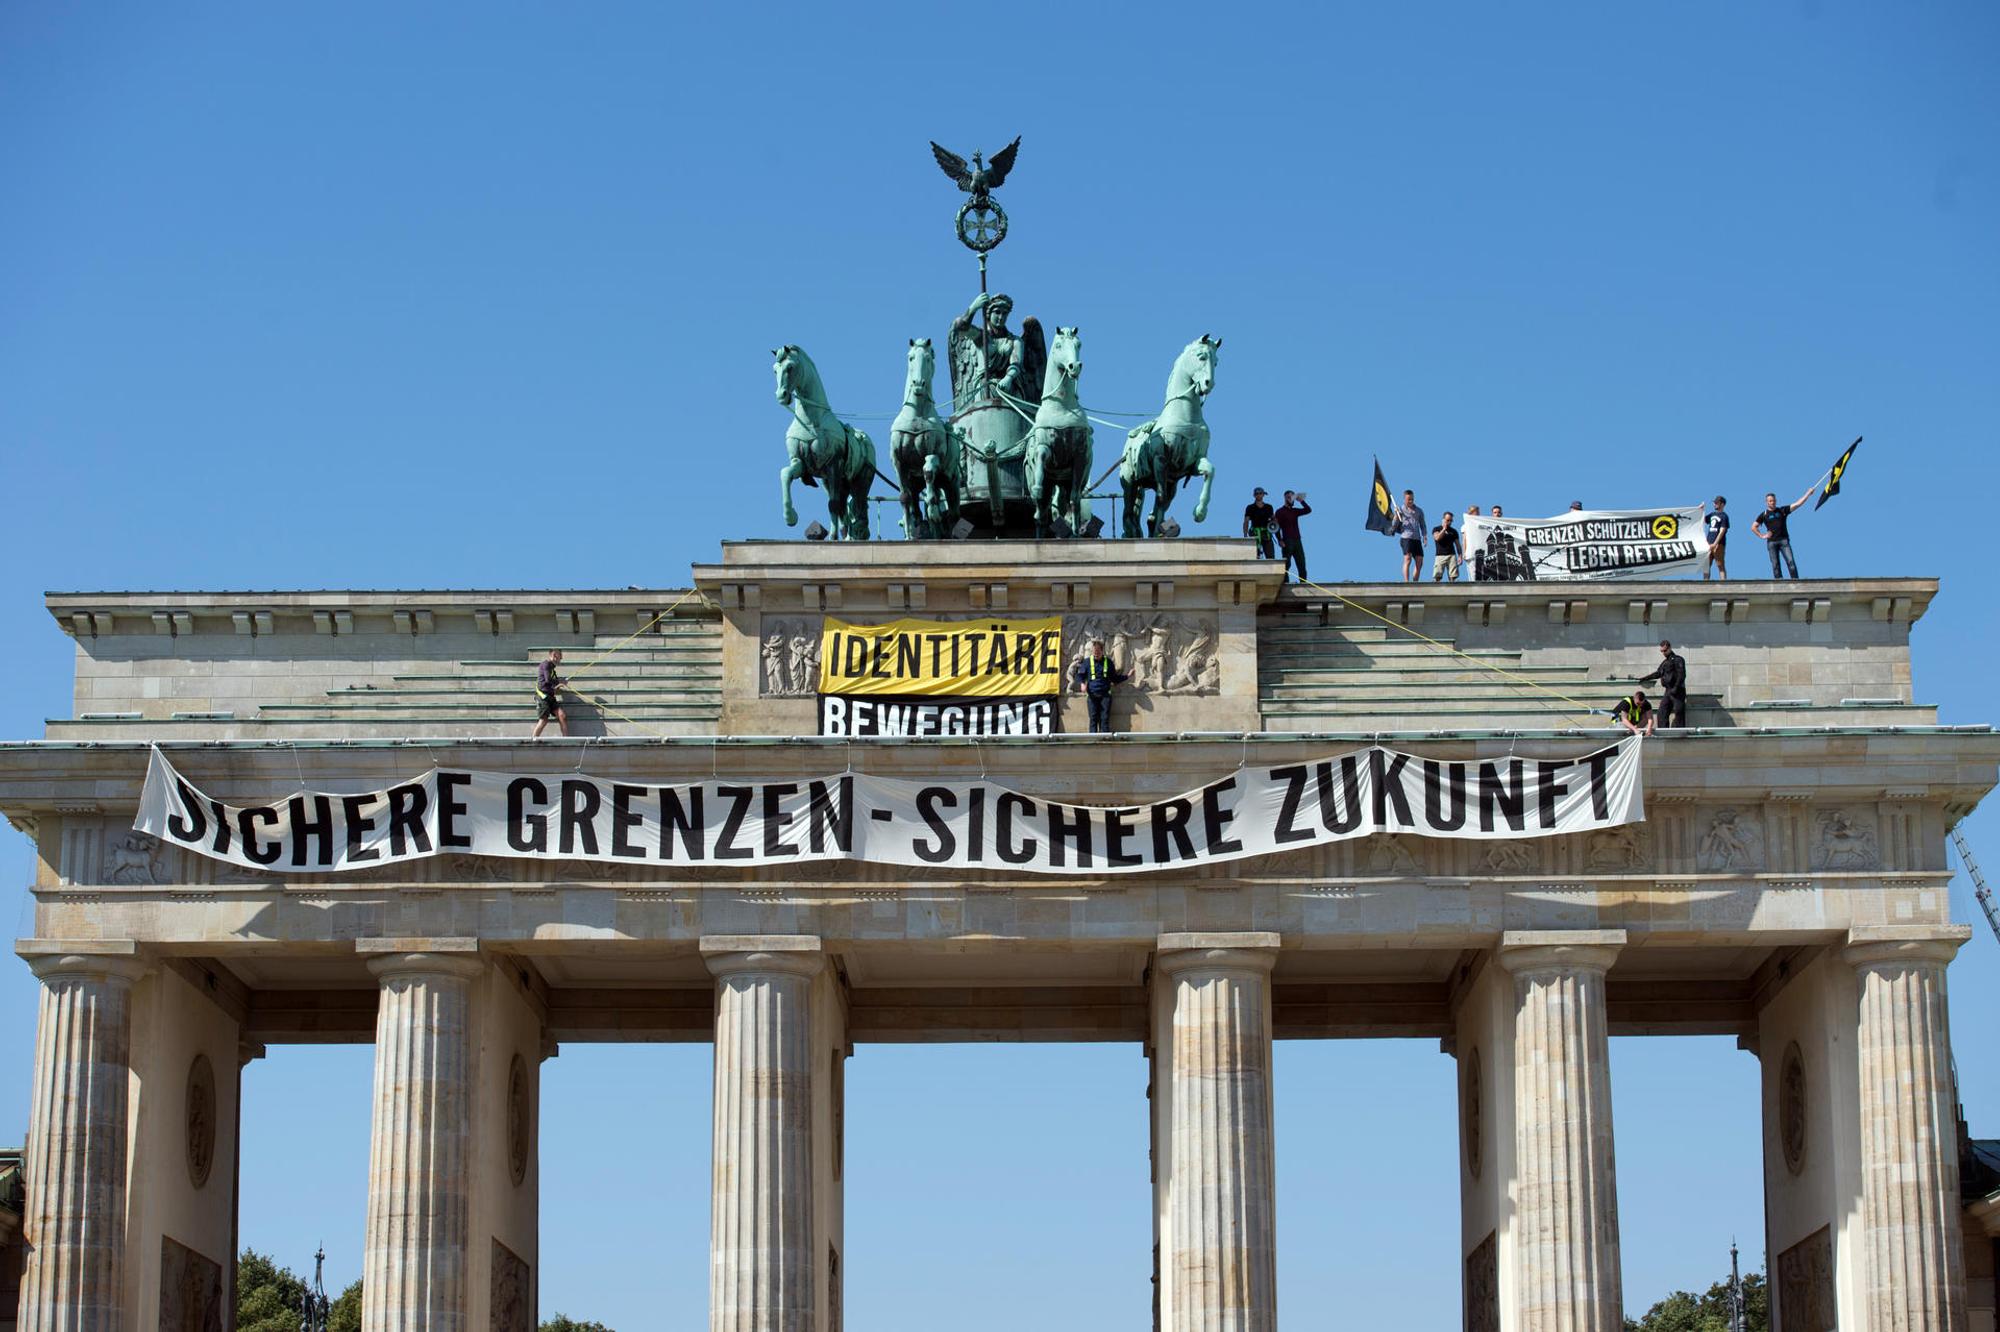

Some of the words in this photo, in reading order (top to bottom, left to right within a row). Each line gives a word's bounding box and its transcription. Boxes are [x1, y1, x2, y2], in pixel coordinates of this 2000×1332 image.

[1528, 524, 1584, 545] GRENZEN
[1587, 518, 1651, 541] SCHÜTZEN!
[1569, 546, 1619, 571] LEBEN
[1625, 542, 1693, 565] RETTEN!
[830, 624, 1060, 679] IDENTITÄRE
[823, 696, 1051, 737] BEWEGUNG
[168, 772, 472, 865] SICHERE
[507, 776, 854, 861] GRENZEN
[913, 776, 1243, 868] SICHERE
[1270, 745, 1619, 845] ZUKUNFT
